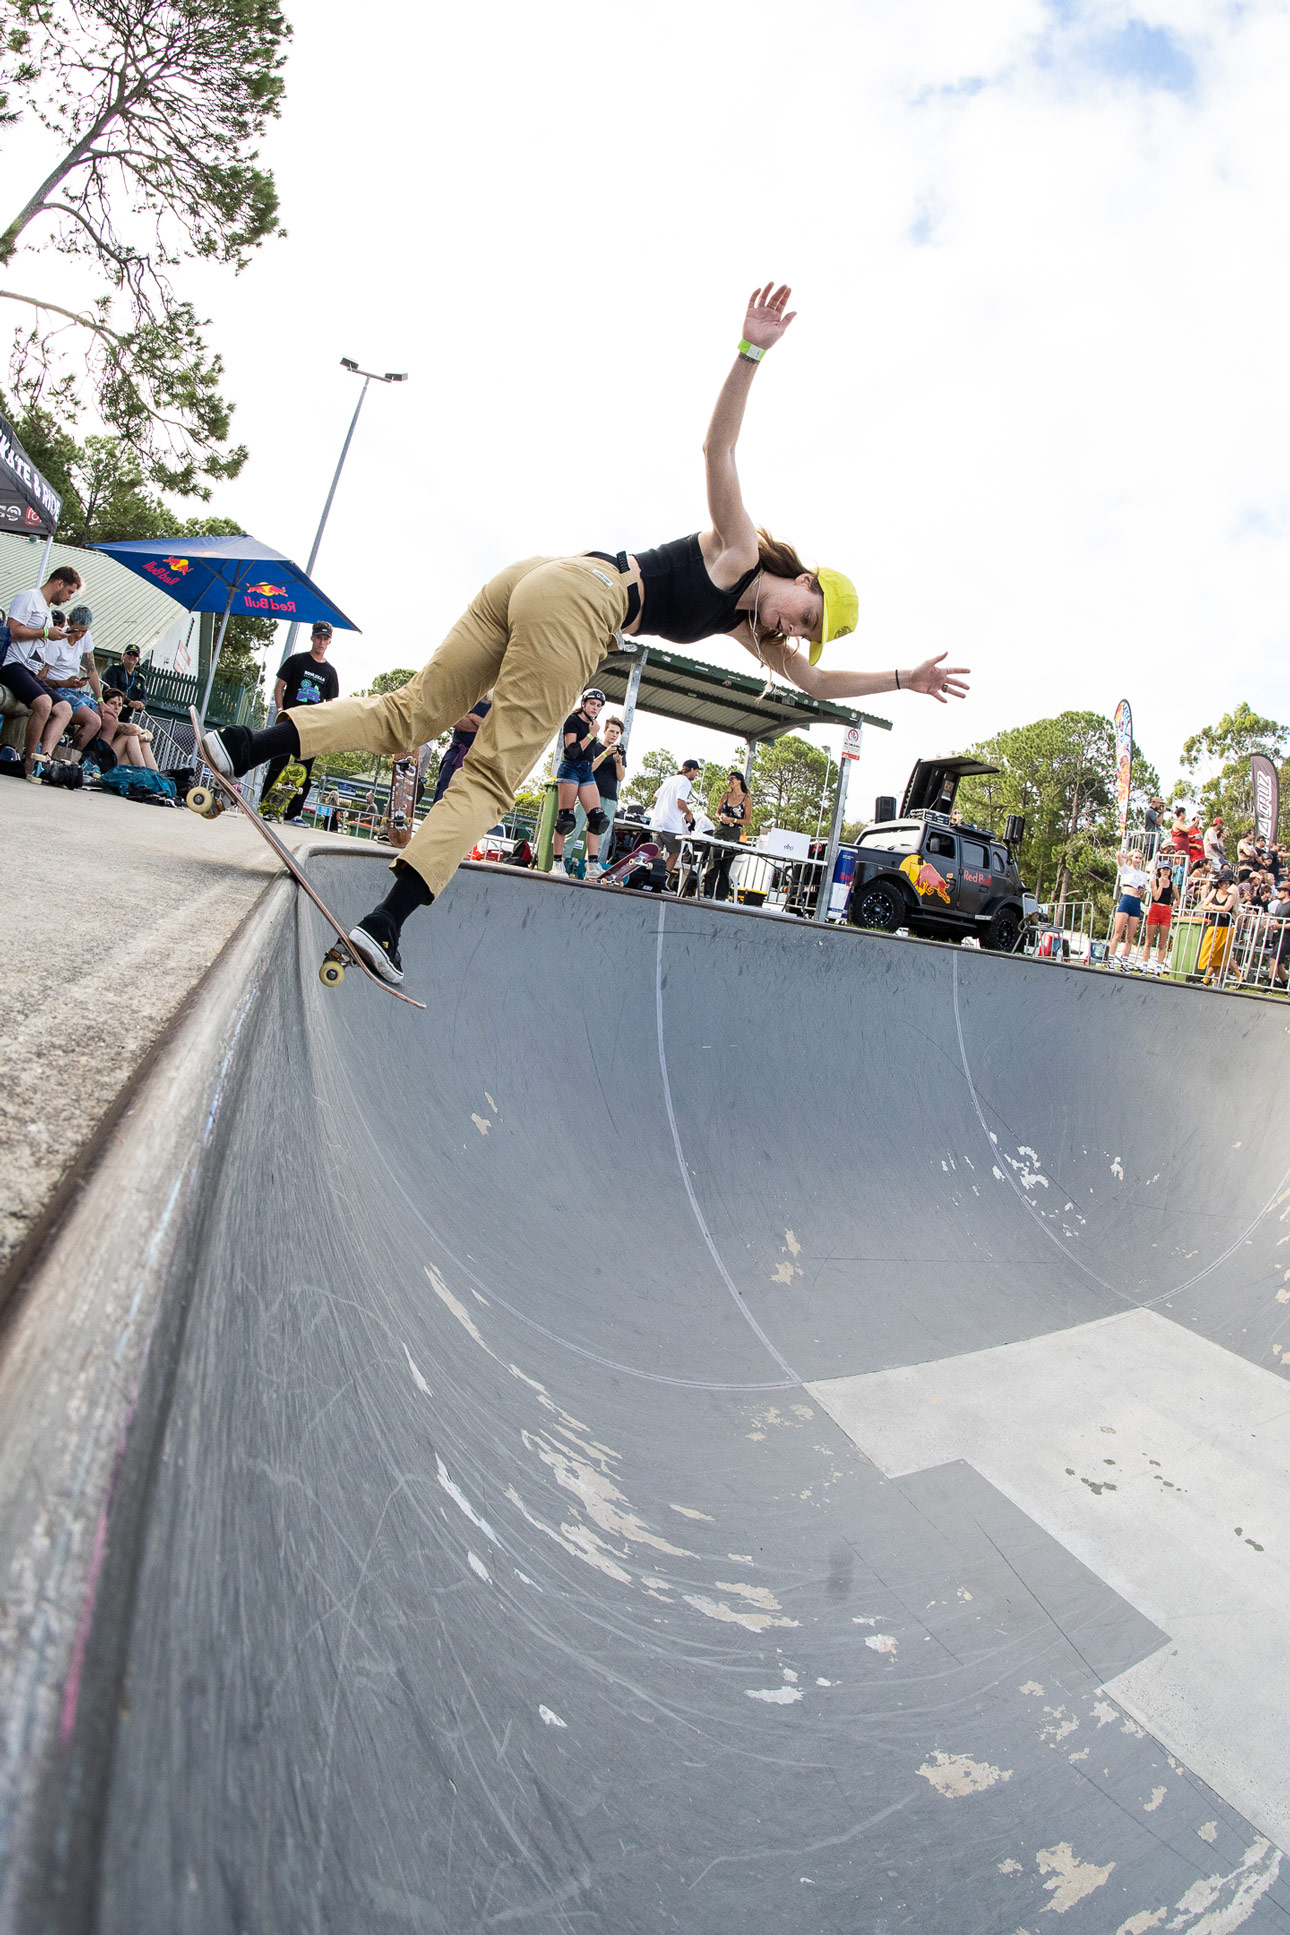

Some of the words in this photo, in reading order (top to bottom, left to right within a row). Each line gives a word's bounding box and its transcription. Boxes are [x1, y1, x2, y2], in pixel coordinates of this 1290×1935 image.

[0, 428, 33, 489] KATE
[1257, 770, 1272, 818] CRUZ
[963, 869, 978, 883] Red
